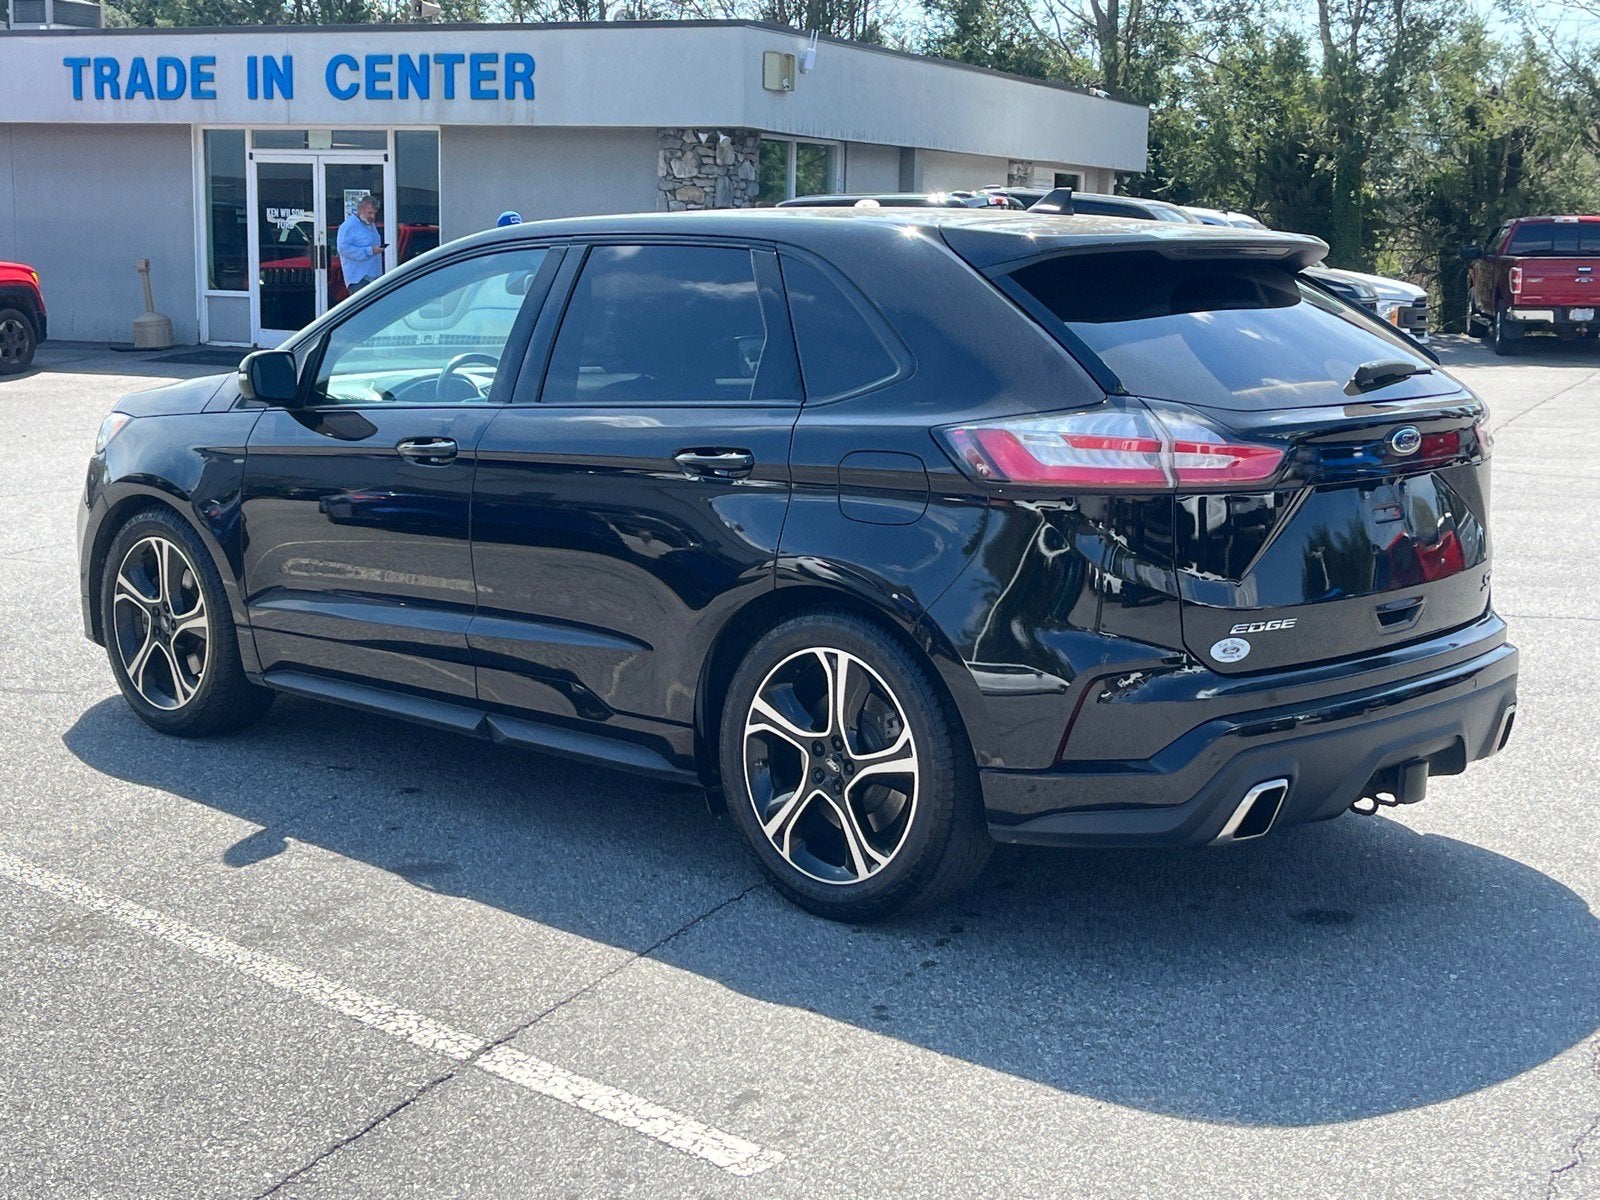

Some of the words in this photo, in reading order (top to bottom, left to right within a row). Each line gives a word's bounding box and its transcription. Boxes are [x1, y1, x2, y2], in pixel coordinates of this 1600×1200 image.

[63, 56, 217, 101] TRADE
[247, 55, 294, 100] IN
[325, 53, 535, 100] CENTER
[266, 208, 279, 217] KEN
[1229, 618, 1298, 634] EDGE
